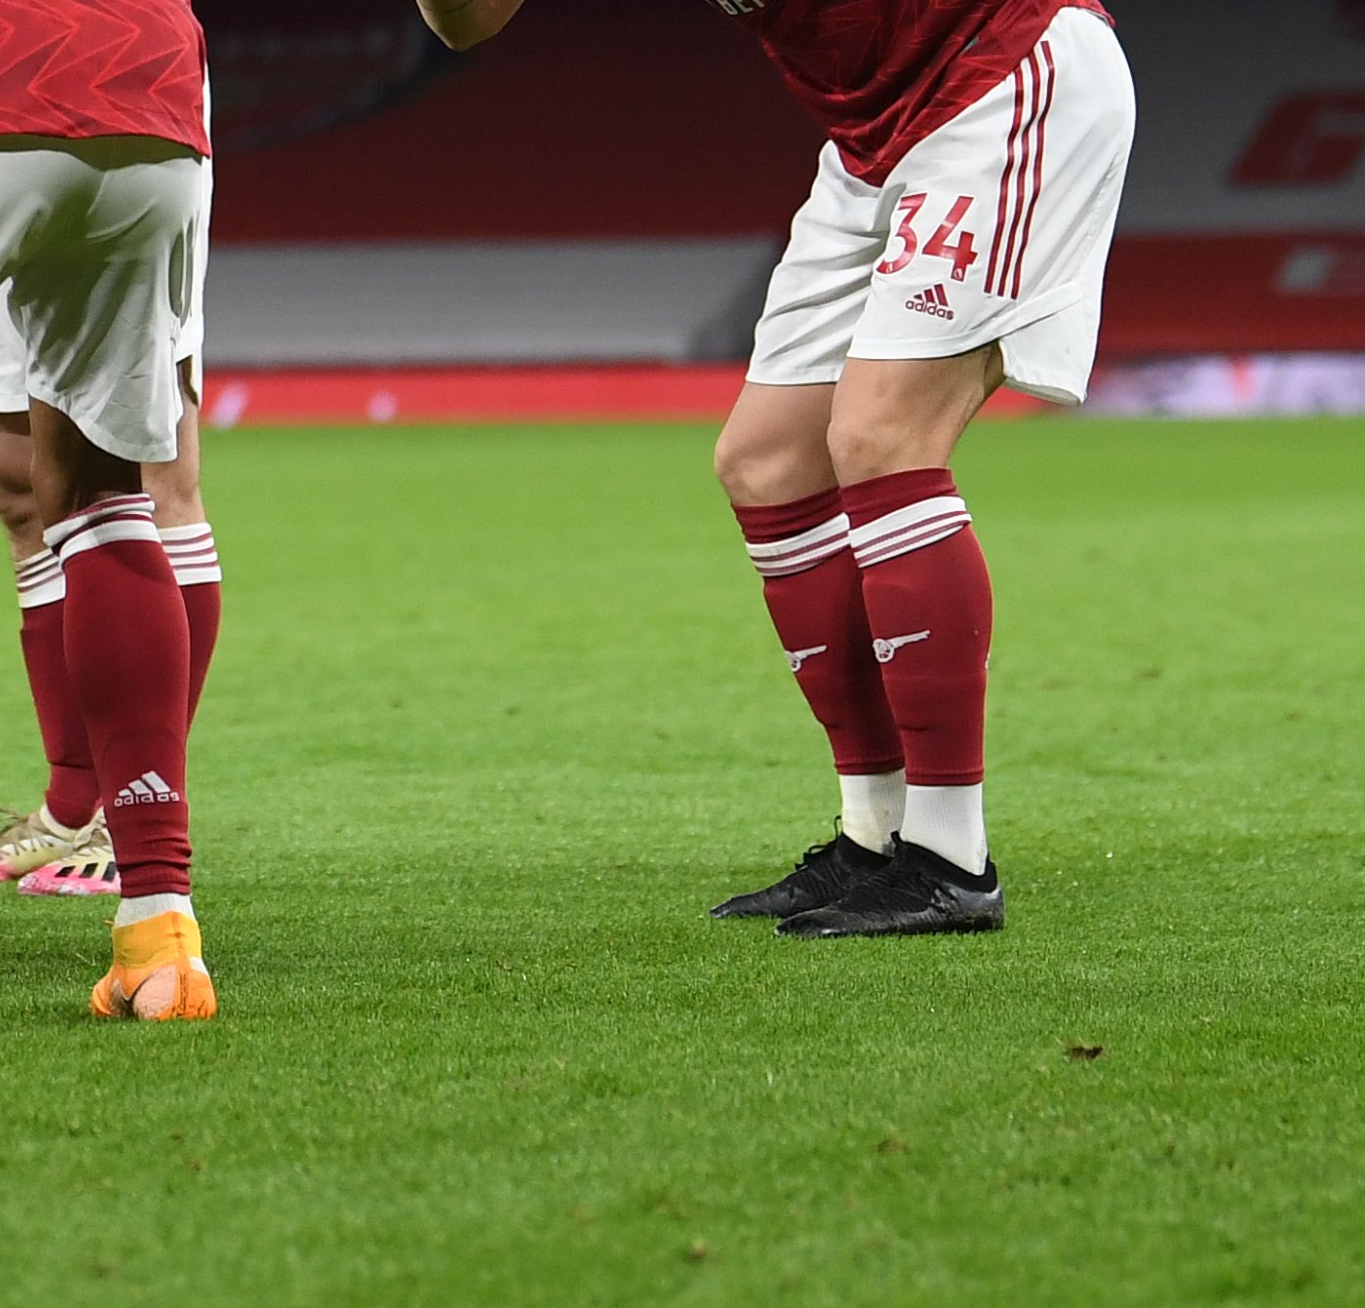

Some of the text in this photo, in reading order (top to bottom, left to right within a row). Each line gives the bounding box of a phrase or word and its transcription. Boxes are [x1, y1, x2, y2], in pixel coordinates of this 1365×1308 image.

[875, 192, 978, 282] 34
[905, 299, 954, 321] adidas
[114, 791, 180, 807] adidas
